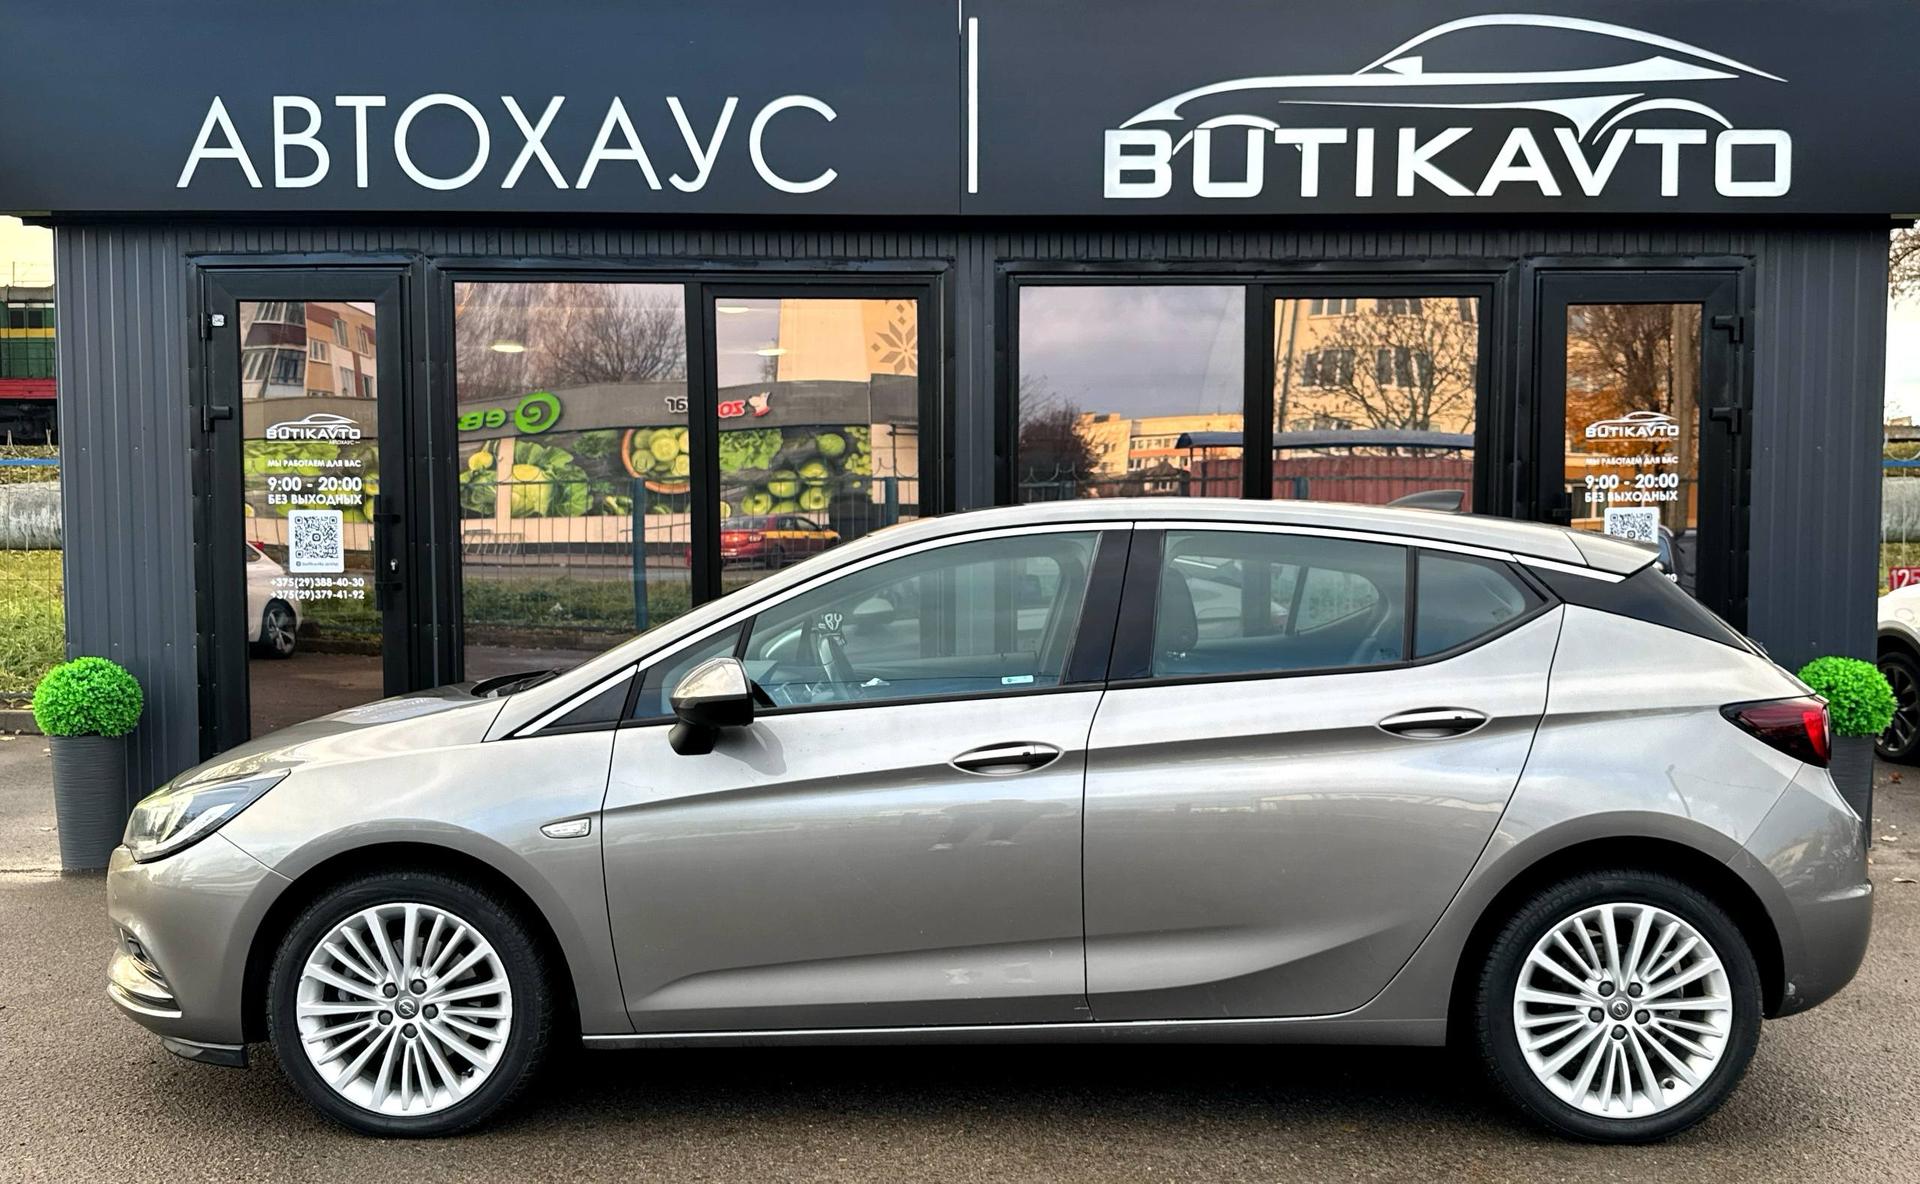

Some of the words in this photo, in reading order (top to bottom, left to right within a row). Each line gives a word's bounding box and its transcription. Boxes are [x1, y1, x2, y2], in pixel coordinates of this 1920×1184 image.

[177, 94, 837, 194] АВТОХАУС
[1104, 126, 1792, 199] BUTIKAVTO
[266, 427, 361, 440] BUTIKAVTO
[1585, 425, 1680, 438] BUTIKAVTO
[267, 459, 282, 467] МЫ
[283, 459, 325, 467] РАБОТАЕМ
[326, 459, 343, 468] ДЛЯ
[344, 459, 362, 467] ВАС
[1601, 457, 1643, 465] РАБОТАЕМ
[1644, 456, 1660, 466] ДЛЯ
[1661, 455, 1679, 464] ВАС
[267, 476, 302, 491] 9:00
[318, 476, 362, 491] 20:00
[1585, 474, 1619, 490] 9:00
[1635, 473, 1679, 489] 20:00
[268, 494, 288, 505] БЕЗ
[291, 494, 362, 506] ВЫХОДНЫХ
[1585, 492, 1605, 503] БЕЗ
[1607, 490, 1678, 503] ВЫХОДНЫХ
[270, 577, 365, 589] +375(29)388-40-30
[270, 590, 365, 602] +375(29)379-41-92
